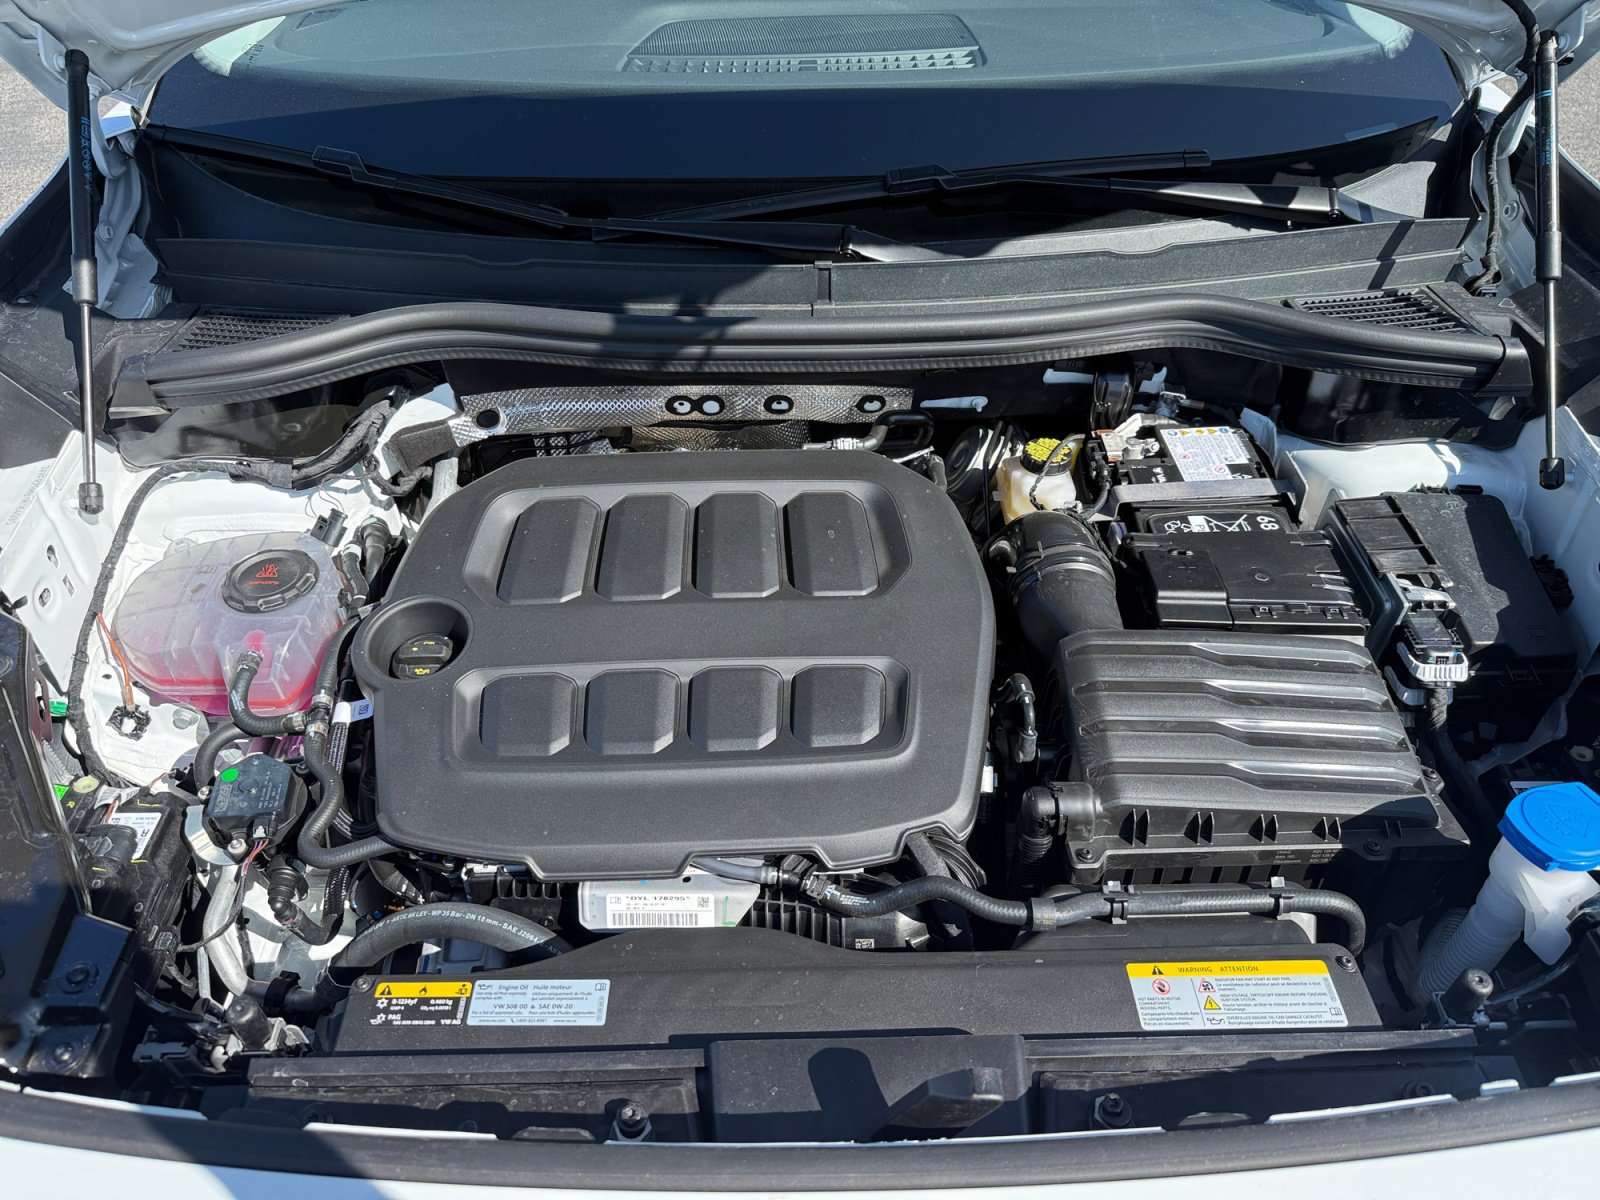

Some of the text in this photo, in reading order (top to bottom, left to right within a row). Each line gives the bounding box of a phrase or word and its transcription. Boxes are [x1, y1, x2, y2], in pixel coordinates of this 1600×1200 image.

[1256, 516, 1279, 531] 68
[502, 922, 519, 934] SAE
[391, 998, 418, 1006] R-1234yf
